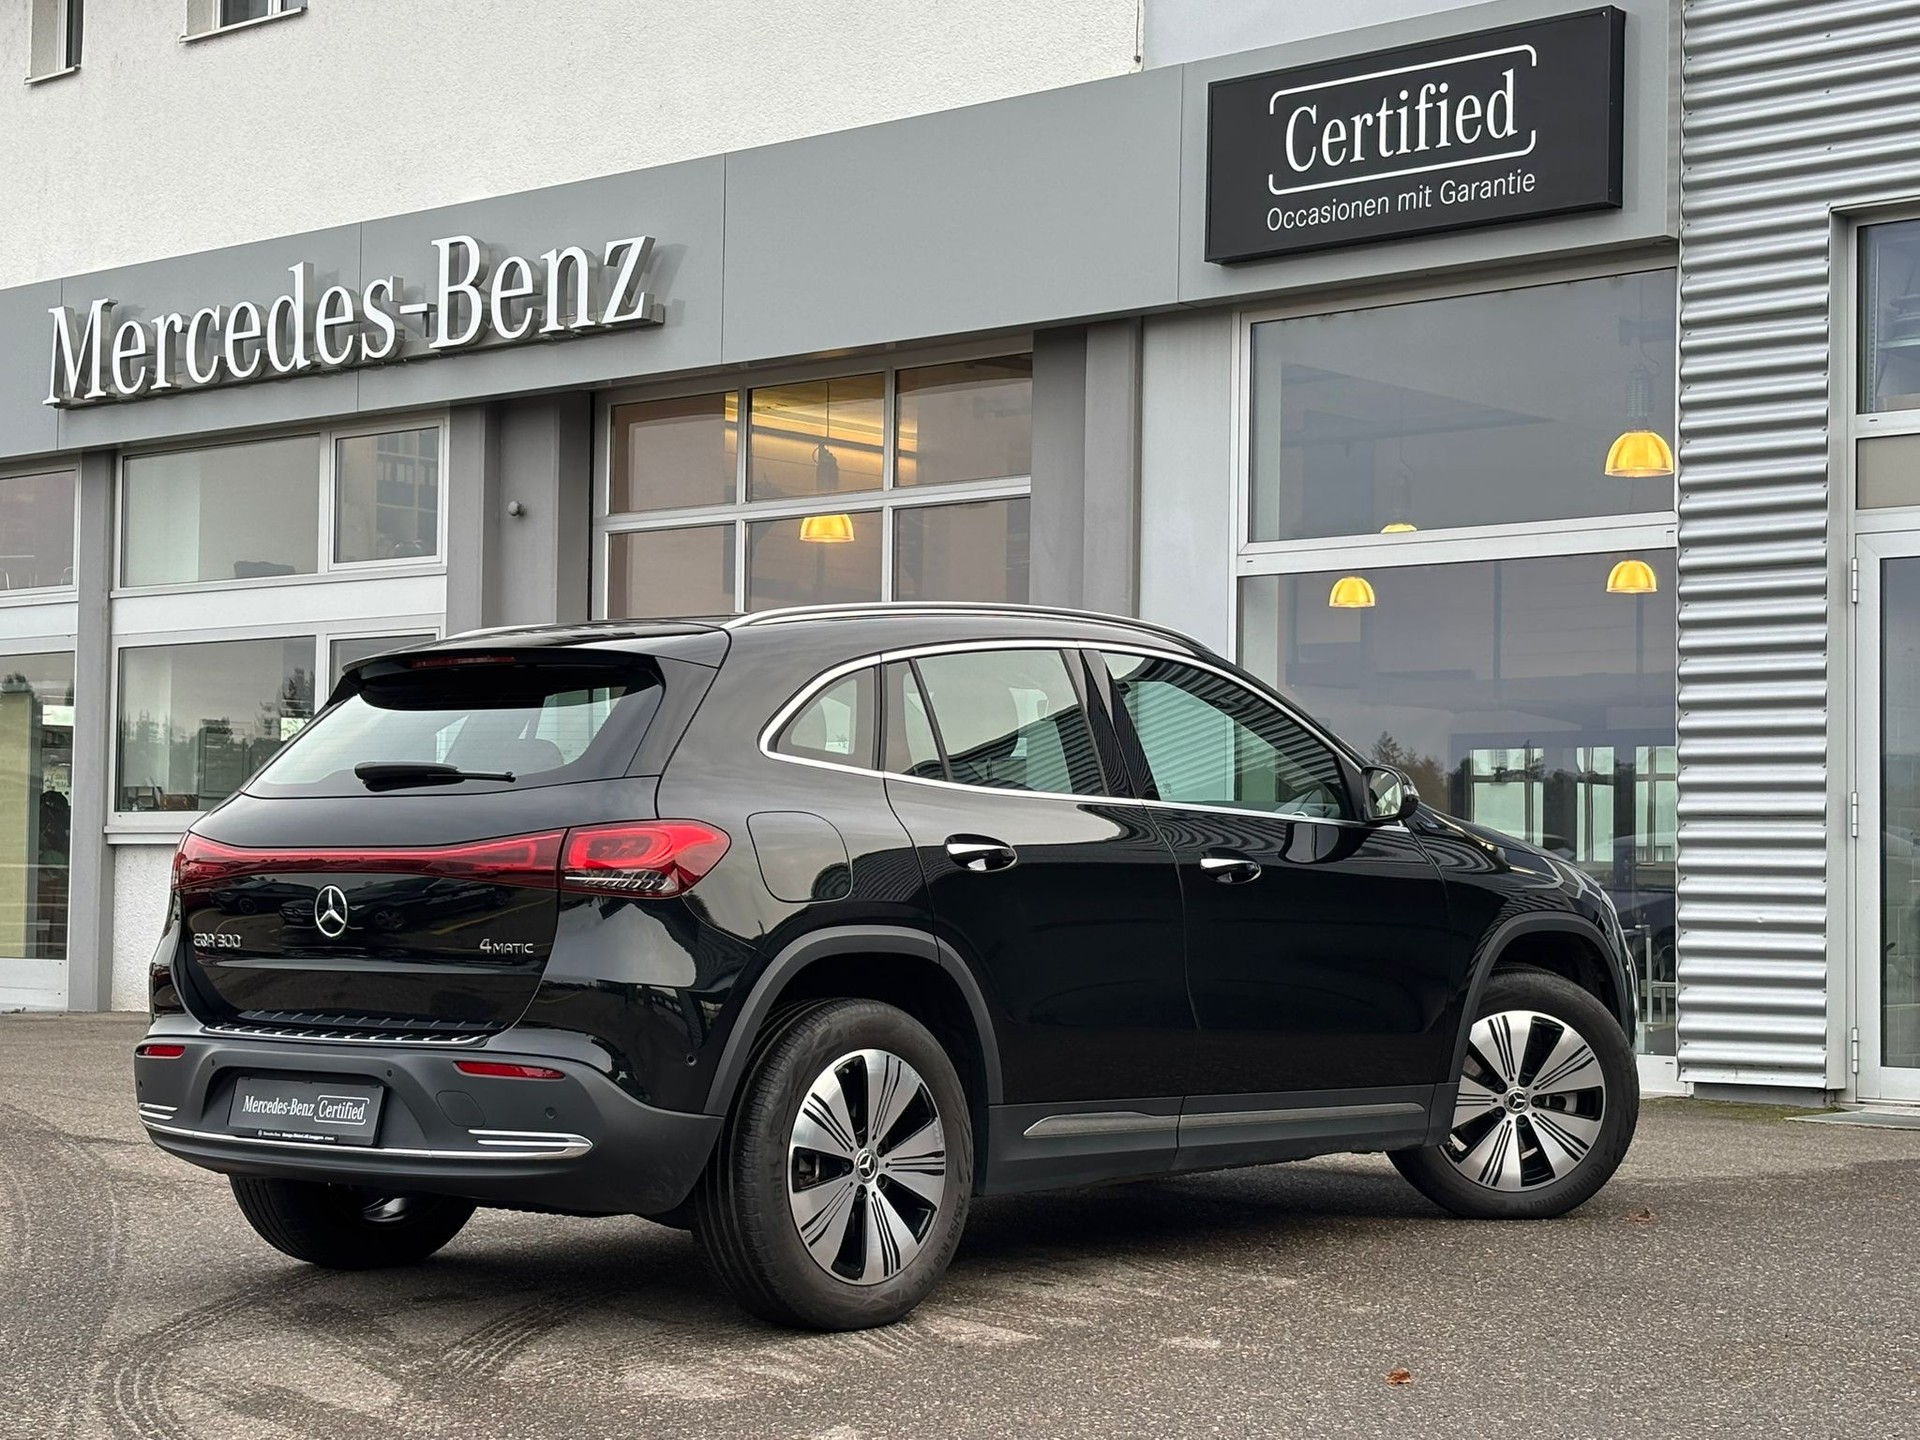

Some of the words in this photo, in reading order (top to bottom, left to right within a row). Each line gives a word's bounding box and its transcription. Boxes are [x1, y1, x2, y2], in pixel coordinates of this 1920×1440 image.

[1285, 68, 1518, 172] Certified
[1266, 196, 1389, 231] Occasionen
[1398, 184, 1432, 211] mit
[1440, 168, 1536, 204] Garantie
[43, 235, 657, 407] Mercedes-Benz
[193, 932, 216, 947] EQA
[217, 933, 242, 948] 300
[479, 938, 534, 954] 4MATIC
[242, 1095, 315, 1117] Mercedes-Benz
[318, 1099, 366, 1120] Certified
